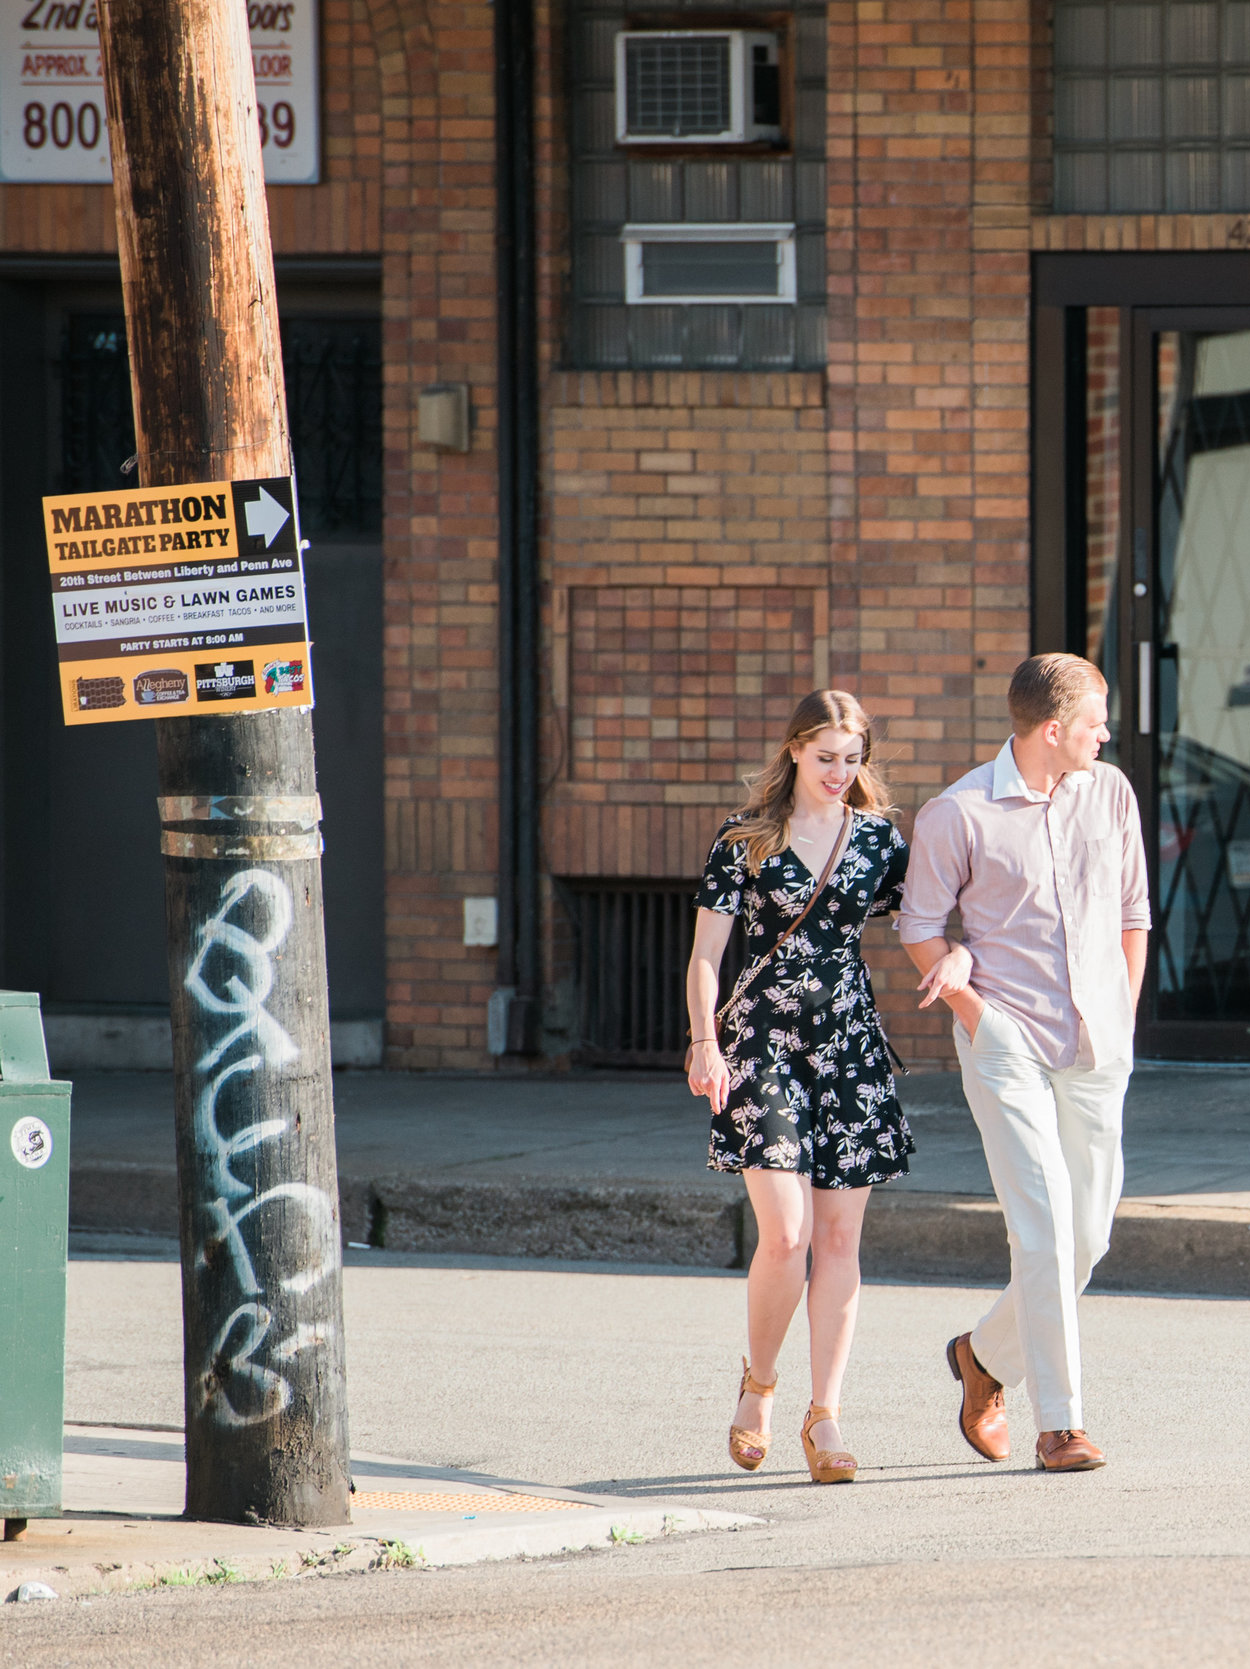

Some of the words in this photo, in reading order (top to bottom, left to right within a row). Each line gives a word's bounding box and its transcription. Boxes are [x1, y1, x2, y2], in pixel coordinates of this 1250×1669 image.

[51, 494, 226, 534] MARATHON
[54, 535, 157, 561] TAILGATE
[159, 528, 230, 552] PARTY
[60, 575, 85, 587] 20th
[87, 571, 122, 584] Street
[124, 569, 172, 581] Between
[174, 564, 214, 577] Liberty
[217, 561, 239, 573] and
[241, 560, 269, 572] Penn
[271, 557, 293, 569] Ave
[63, 602, 100, 617] LIVE
[105, 596, 157, 614] MUSIC
[163, 595, 176, 608] &
[181, 590, 230, 607] LAWN
[236, 585, 295, 602] GAMES
[64, 620, 102, 631] COCKTAILS
[110, 616, 141, 627] SANGRIA
[148, 613, 175, 624] COFFEE
[183, 609, 225, 621] BREAKFAST
[228, 607, 252, 617] TACOS
[259, 605, 275, 614] AND
[276, 603, 296, 613] MORE
[120, 641, 150, 652] PARTY
[152, 637, 190, 649] STARTS
[191, 636, 204, 646] AT
[206, 634, 226, 645] 8:00
[228, 632, 244, 643] AM
[136, 677, 186, 691] Allegheny
[196, 675, 256, 689] PITTSBURGH
[278, 665, 303, 675] BEST
